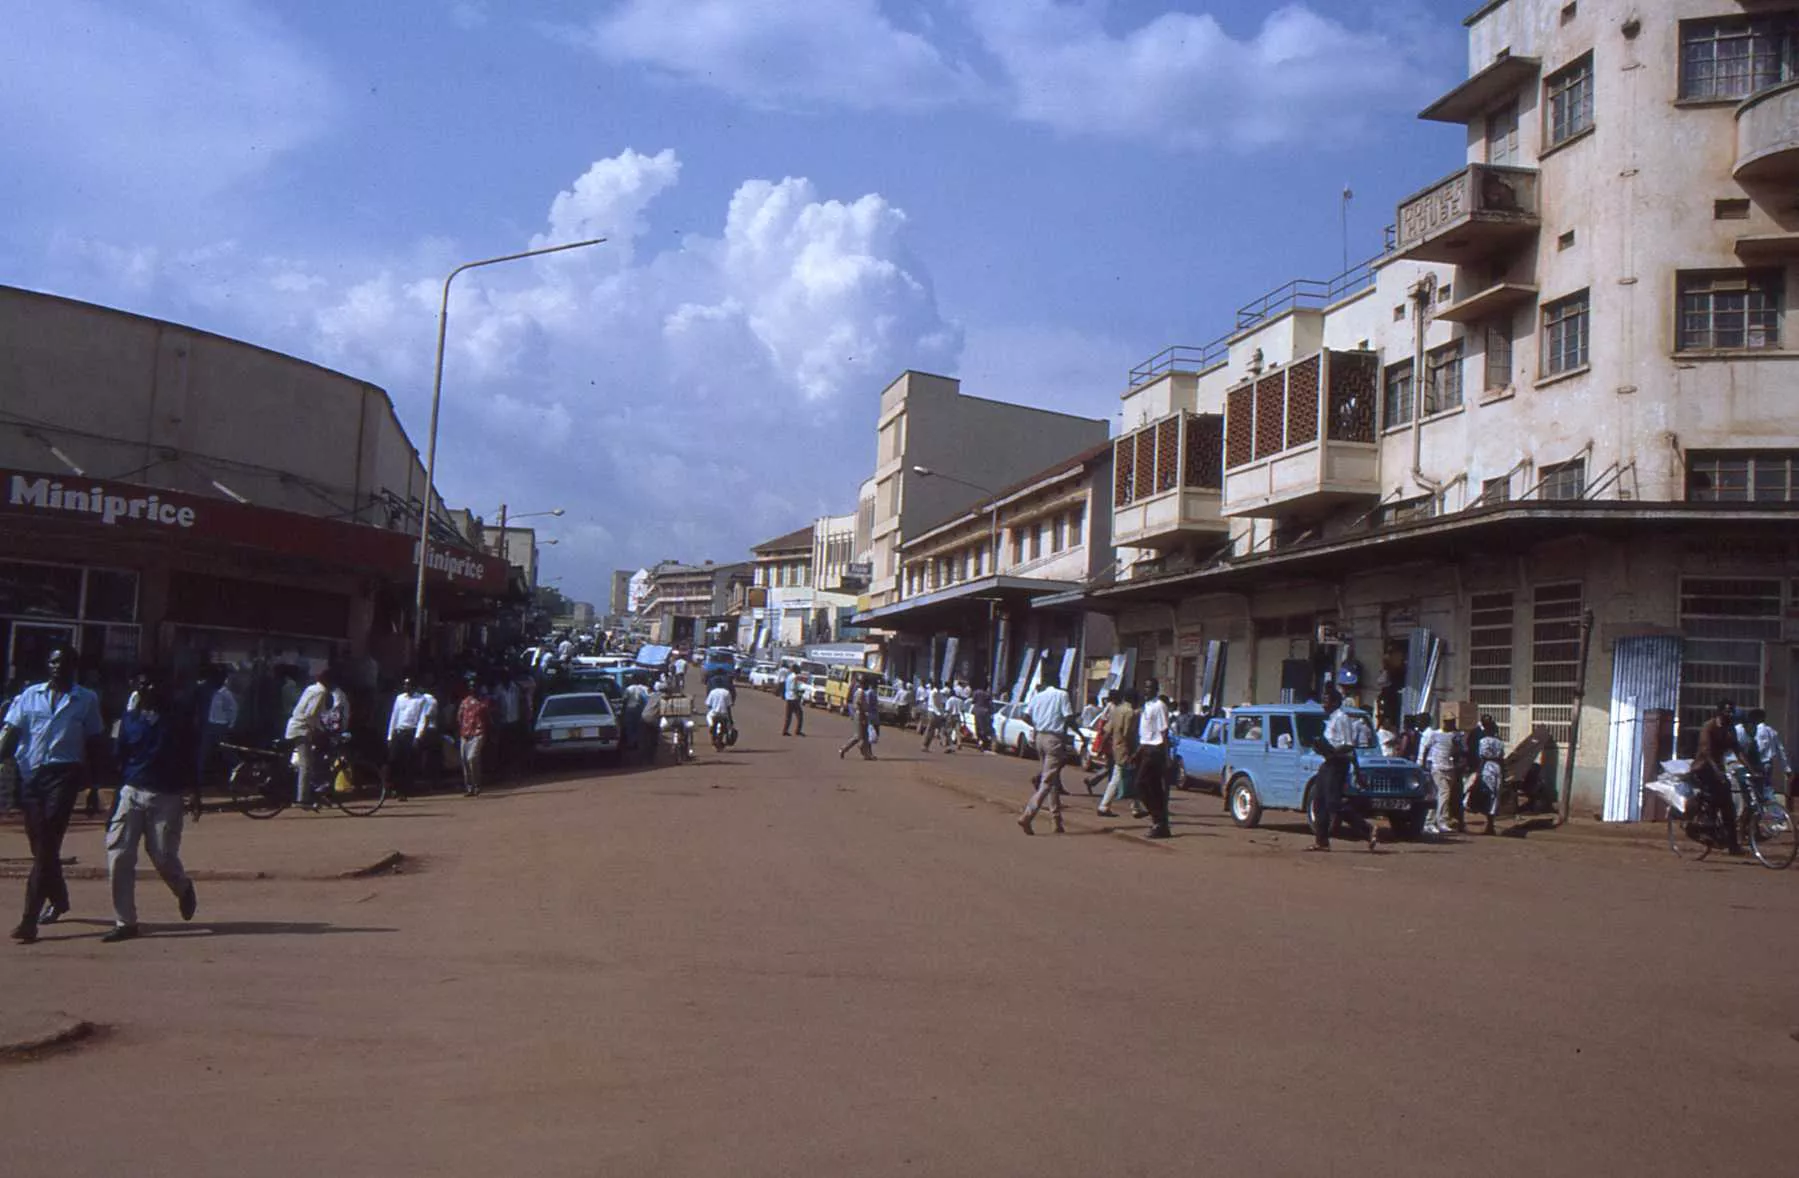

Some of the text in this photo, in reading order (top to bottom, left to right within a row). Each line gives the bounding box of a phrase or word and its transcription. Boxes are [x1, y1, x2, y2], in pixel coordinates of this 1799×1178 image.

[1404, 179, 1465, 222] CORNER
[1406, 199, 1461, 239] HOUSE
[9, 475, 196, 527] Miniprice
